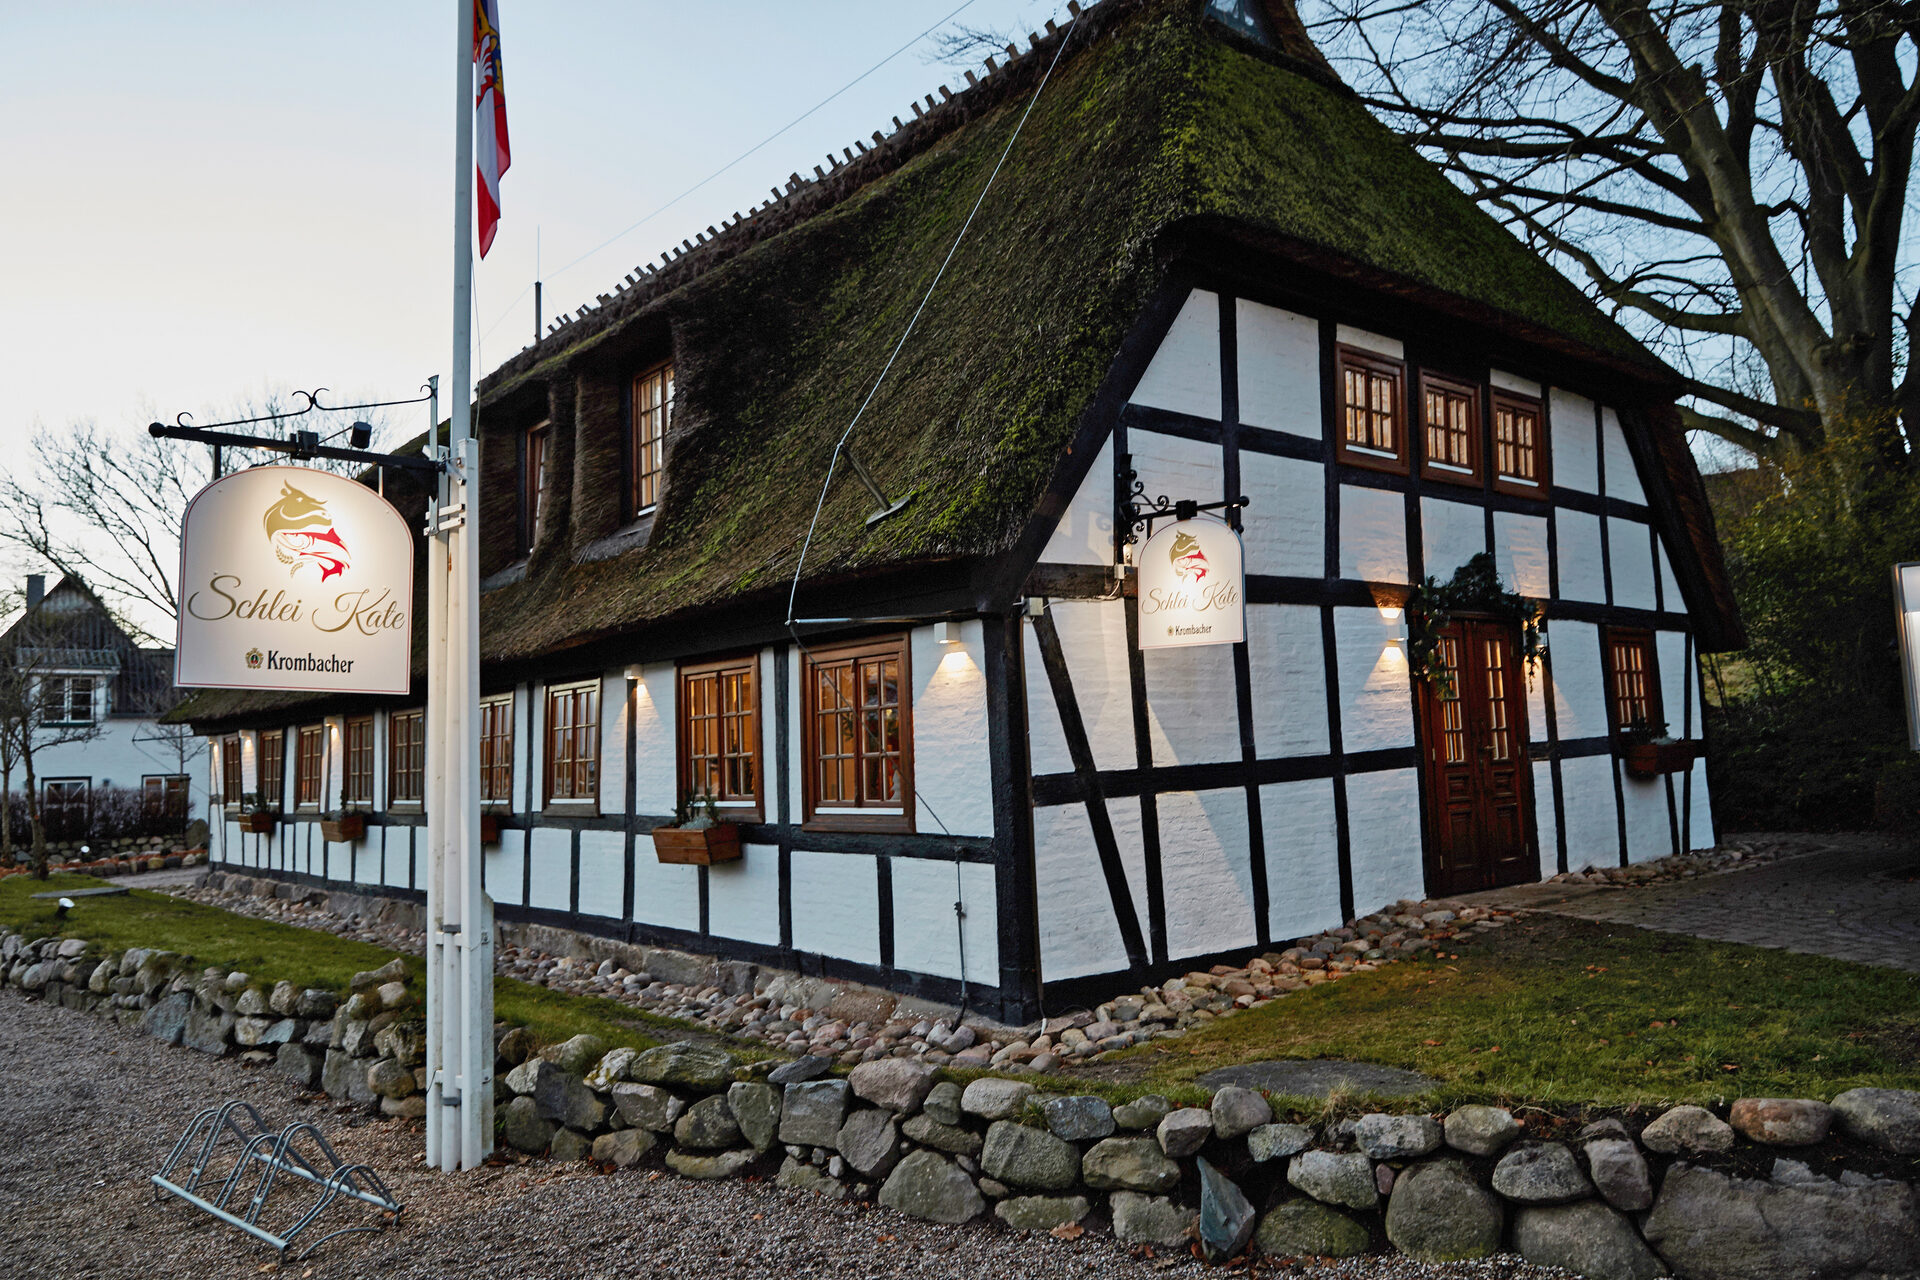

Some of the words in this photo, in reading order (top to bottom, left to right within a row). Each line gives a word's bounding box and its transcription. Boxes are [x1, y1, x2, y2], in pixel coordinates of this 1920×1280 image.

[187, 575, 303, 622] Schlei
[312, 589, 405, 635] Kate
[1141, 588, 1188, 614] Schlei
[1192, 579, 1239, 611] Kate
[1175, 624, 1212, 636] Krombacher
[267, 650, 354, 673] Krombacher
